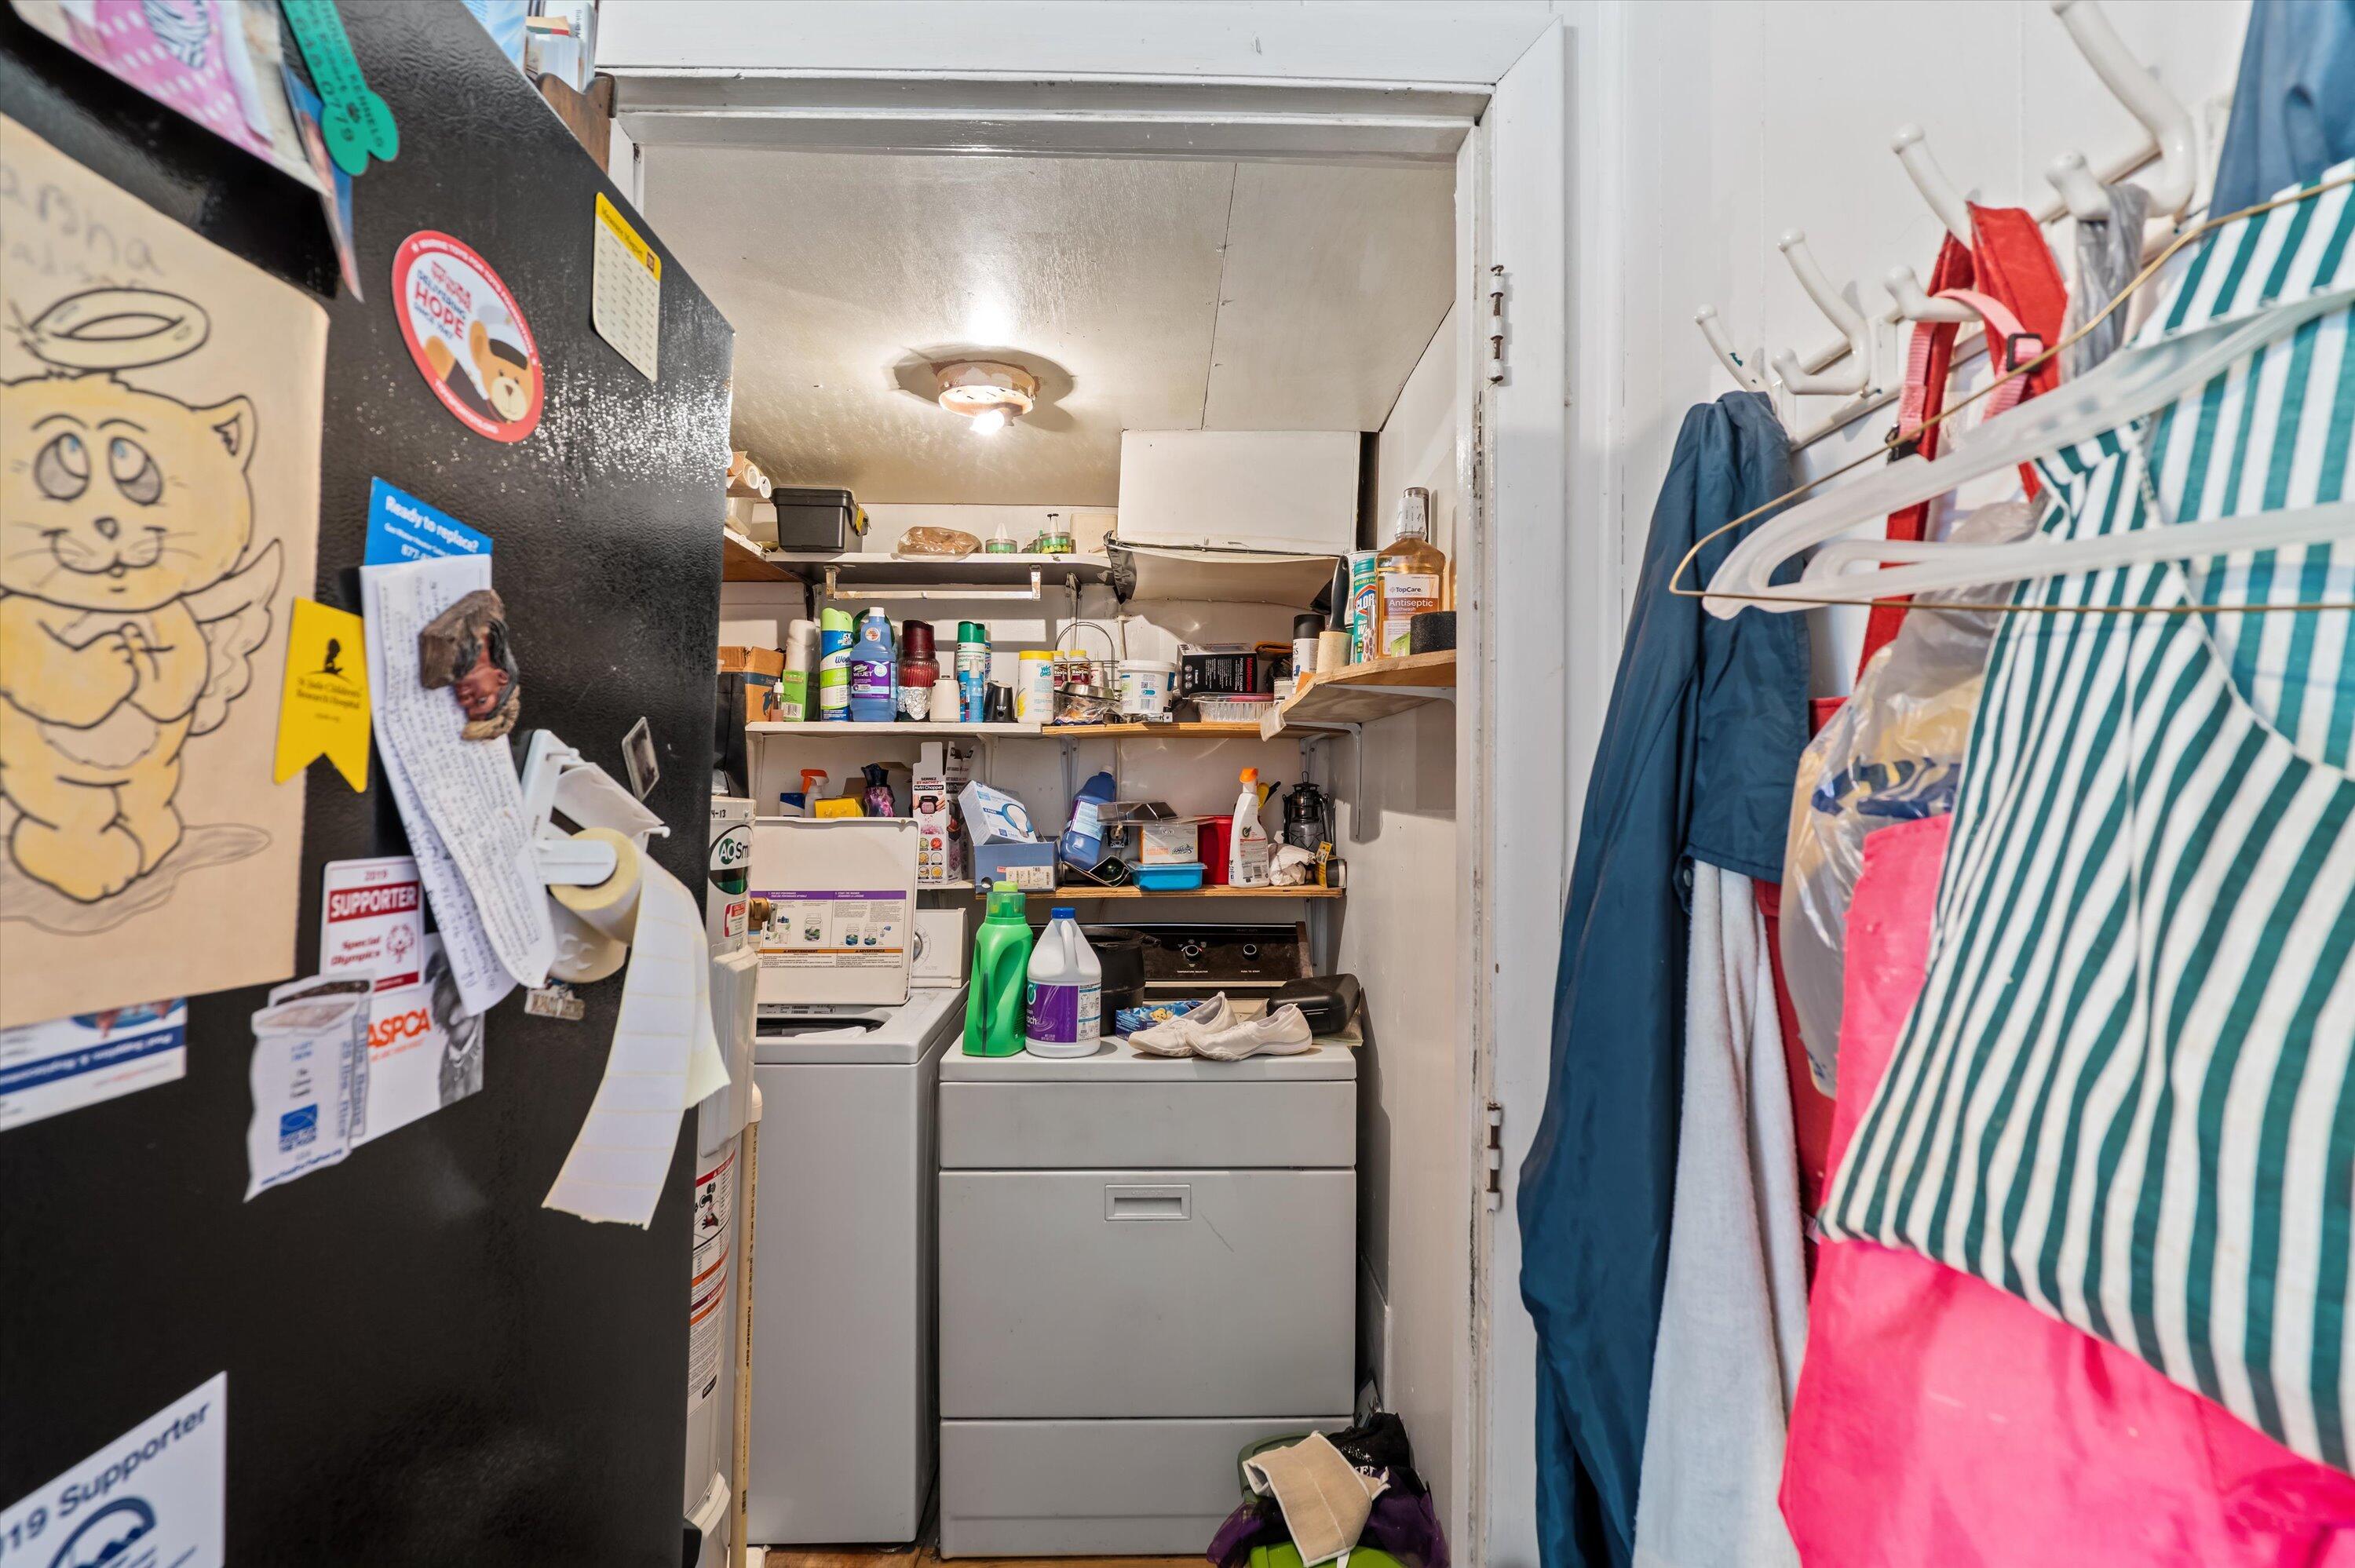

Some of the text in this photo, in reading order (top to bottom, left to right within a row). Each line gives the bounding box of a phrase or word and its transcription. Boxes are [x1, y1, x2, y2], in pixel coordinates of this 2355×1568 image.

[415, 280, 465, 339] HOPE
[385, 494, 424, 529] Ready
[423, 515, 437, 533] to
[436, 524, 480, 553] replace?
[1389, 599, 1433, 607] Antiseptic
[364, 870, 389, 881] 2019
[330, 885, 417, 918] SUPPORTER
[330, 950, 382, 967] Olympics
[341, 935, 382, 950] Special
[367, 1008, 432, 1048] ASPCA
[352, 1074, 366, 1125] Beans
[338, 1100, 349, 1137] Rice
[58, 1402, 210, 1519] Supporter
